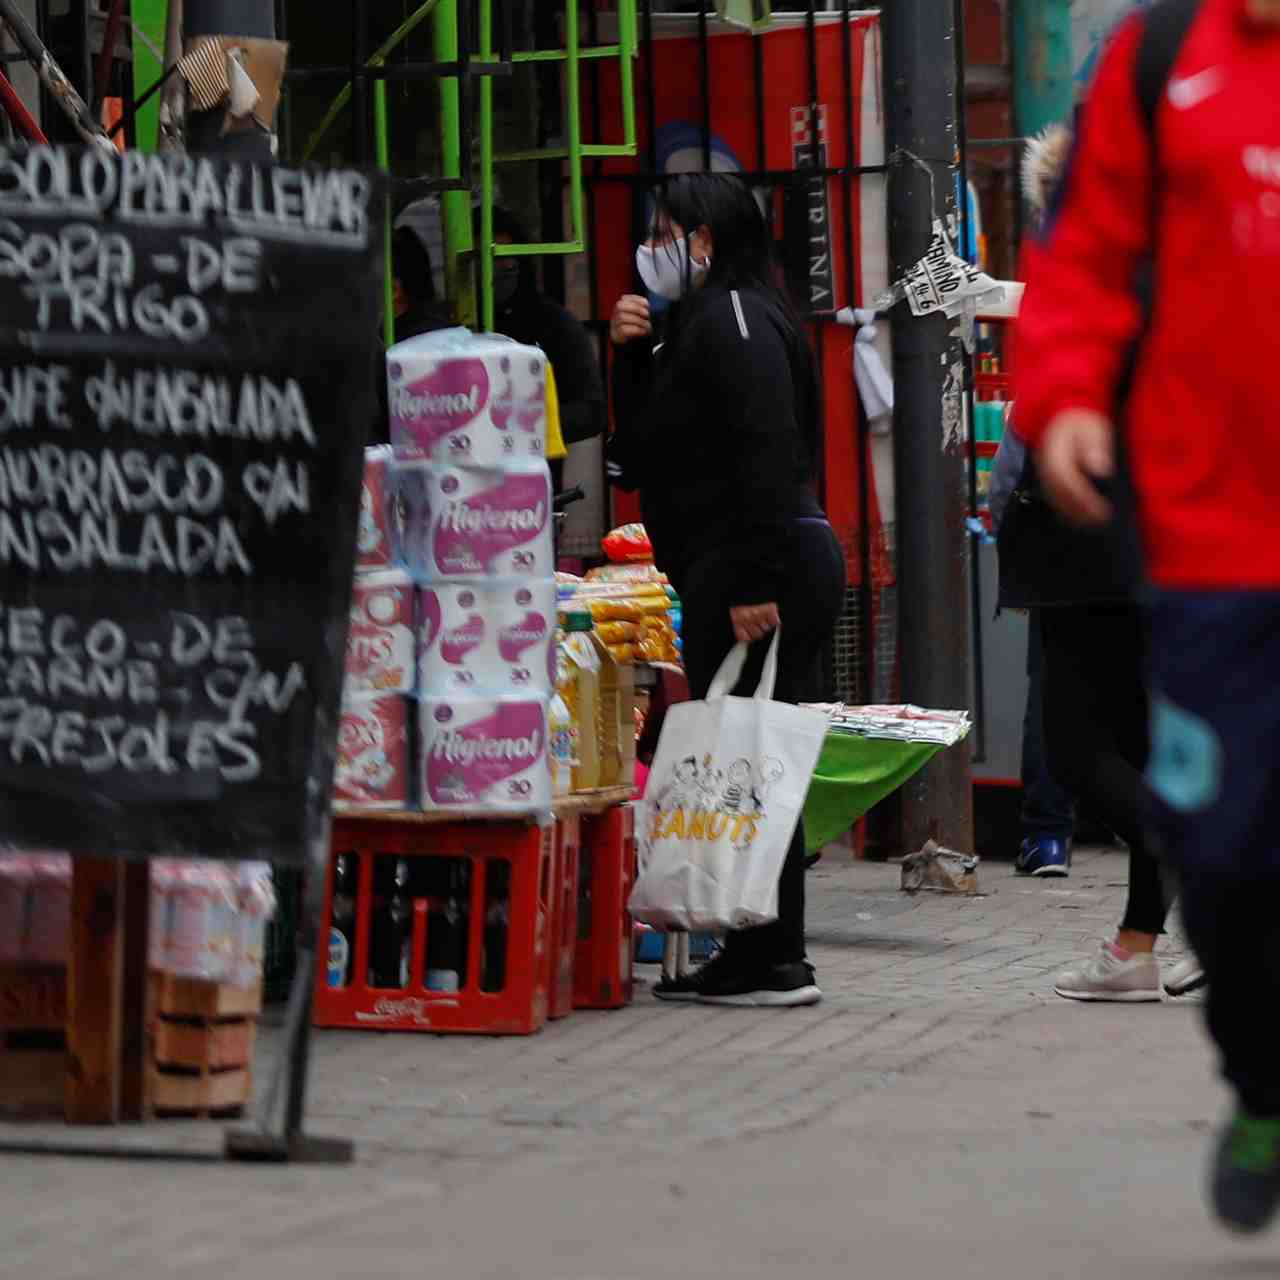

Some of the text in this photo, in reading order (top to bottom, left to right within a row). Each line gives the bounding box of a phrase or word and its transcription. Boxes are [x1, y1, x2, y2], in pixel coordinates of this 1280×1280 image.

[36, 276, 209, 342] TRIGO
[0, 511, 254, 574] NSALADA
[439, 499, 544, 537] Higienol
[5, 606, 127, 665] ECO
[0, 656, 159, 702] ARNE
[432, 727, 538, 767] Higienol
